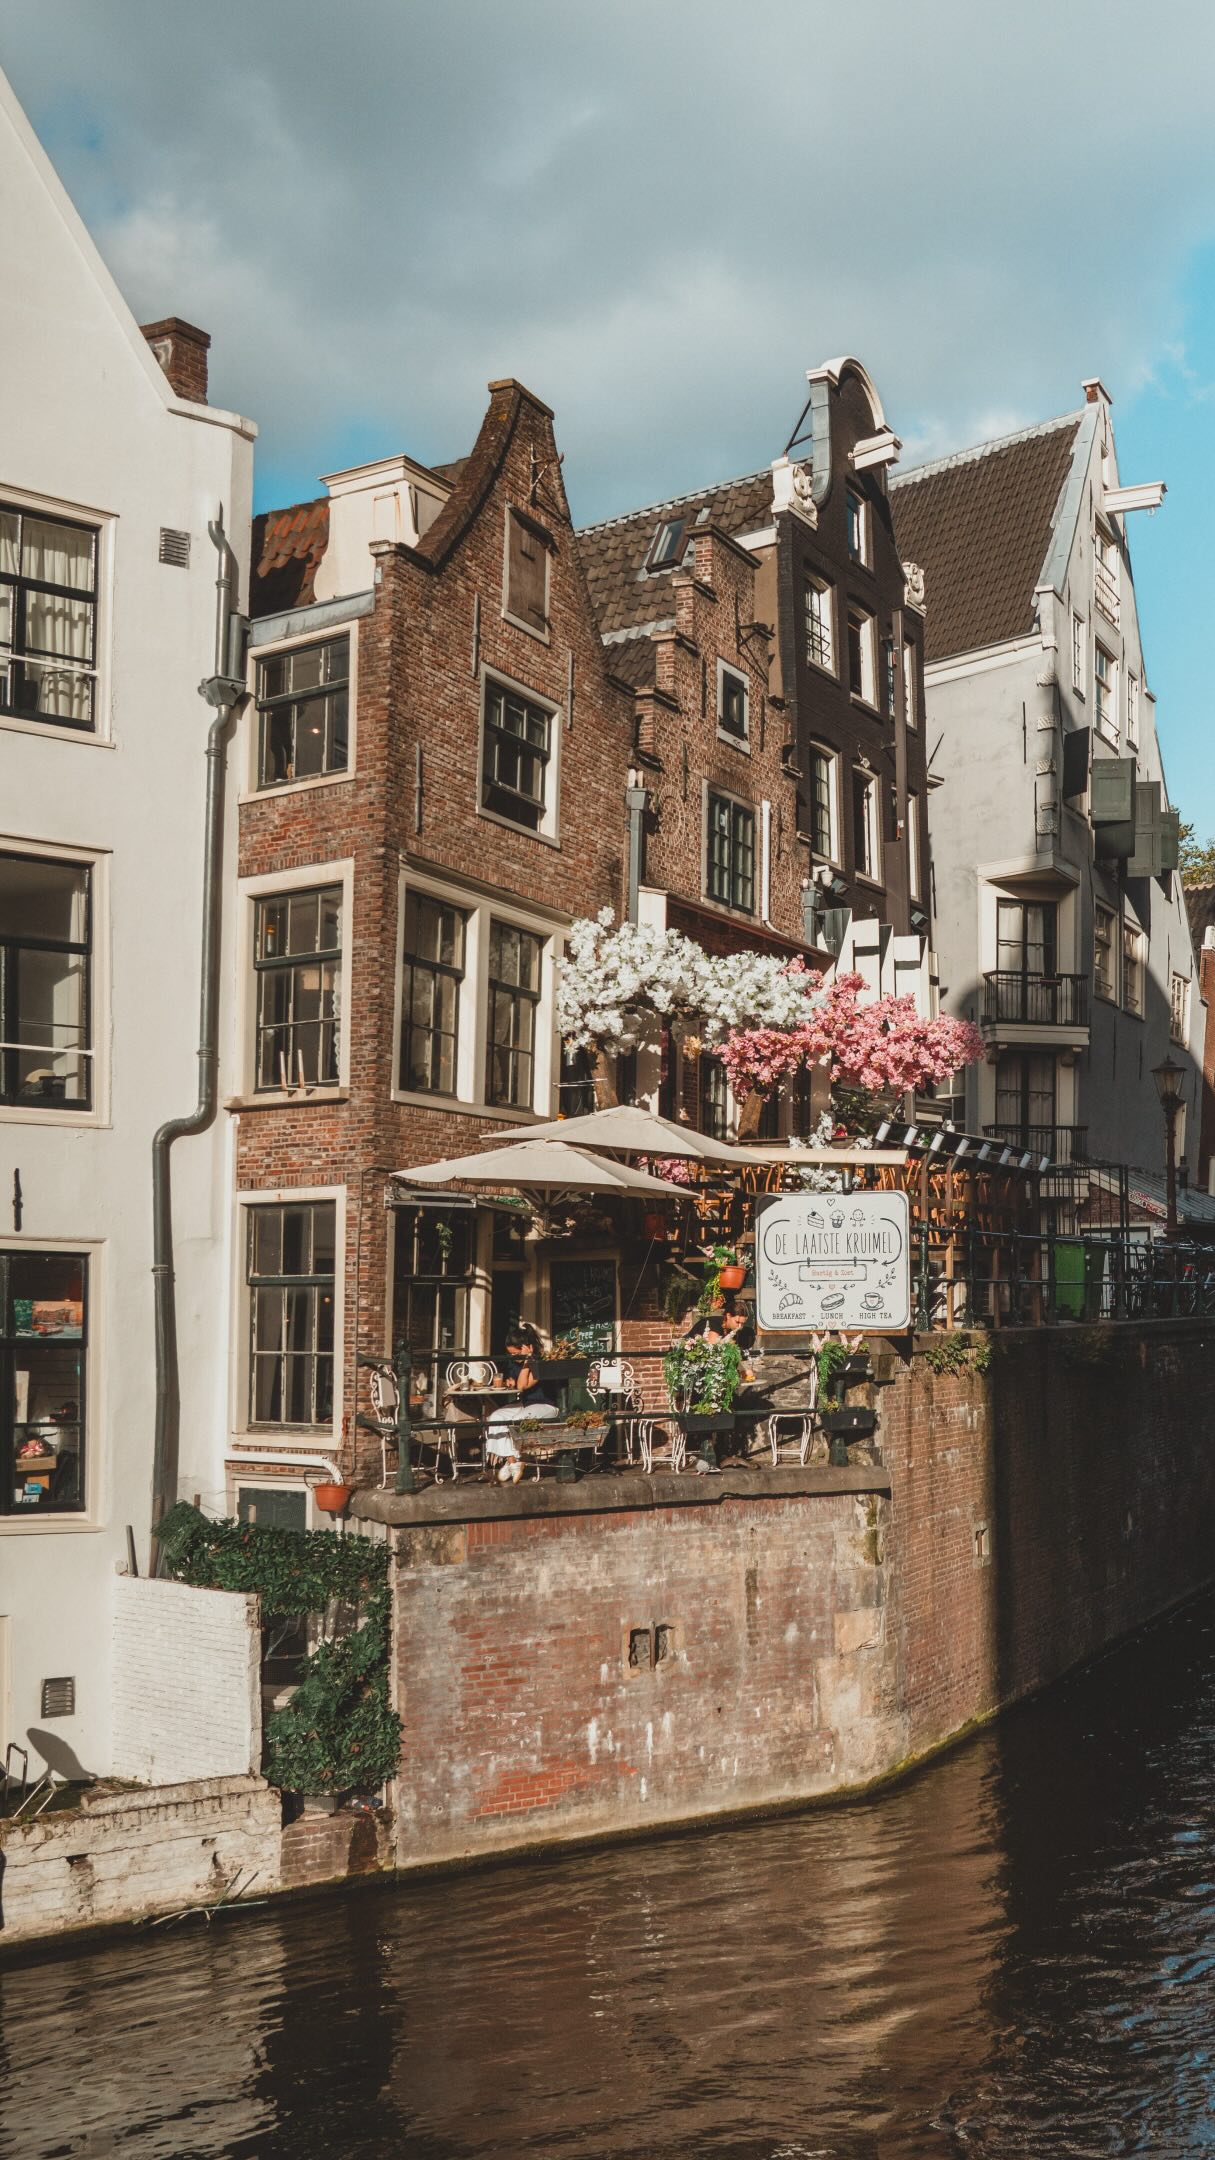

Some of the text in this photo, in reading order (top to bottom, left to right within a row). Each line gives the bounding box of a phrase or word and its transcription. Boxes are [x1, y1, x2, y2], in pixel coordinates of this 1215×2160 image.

[775, 1231, 893, 1255] DE LAATSTE KRUIMEL
[772, 1312, 806, 1320] BREAKFAST
[820, 1312, 844, 1320] LUNCH
[859, 1312, 876, 1320] HIGH
